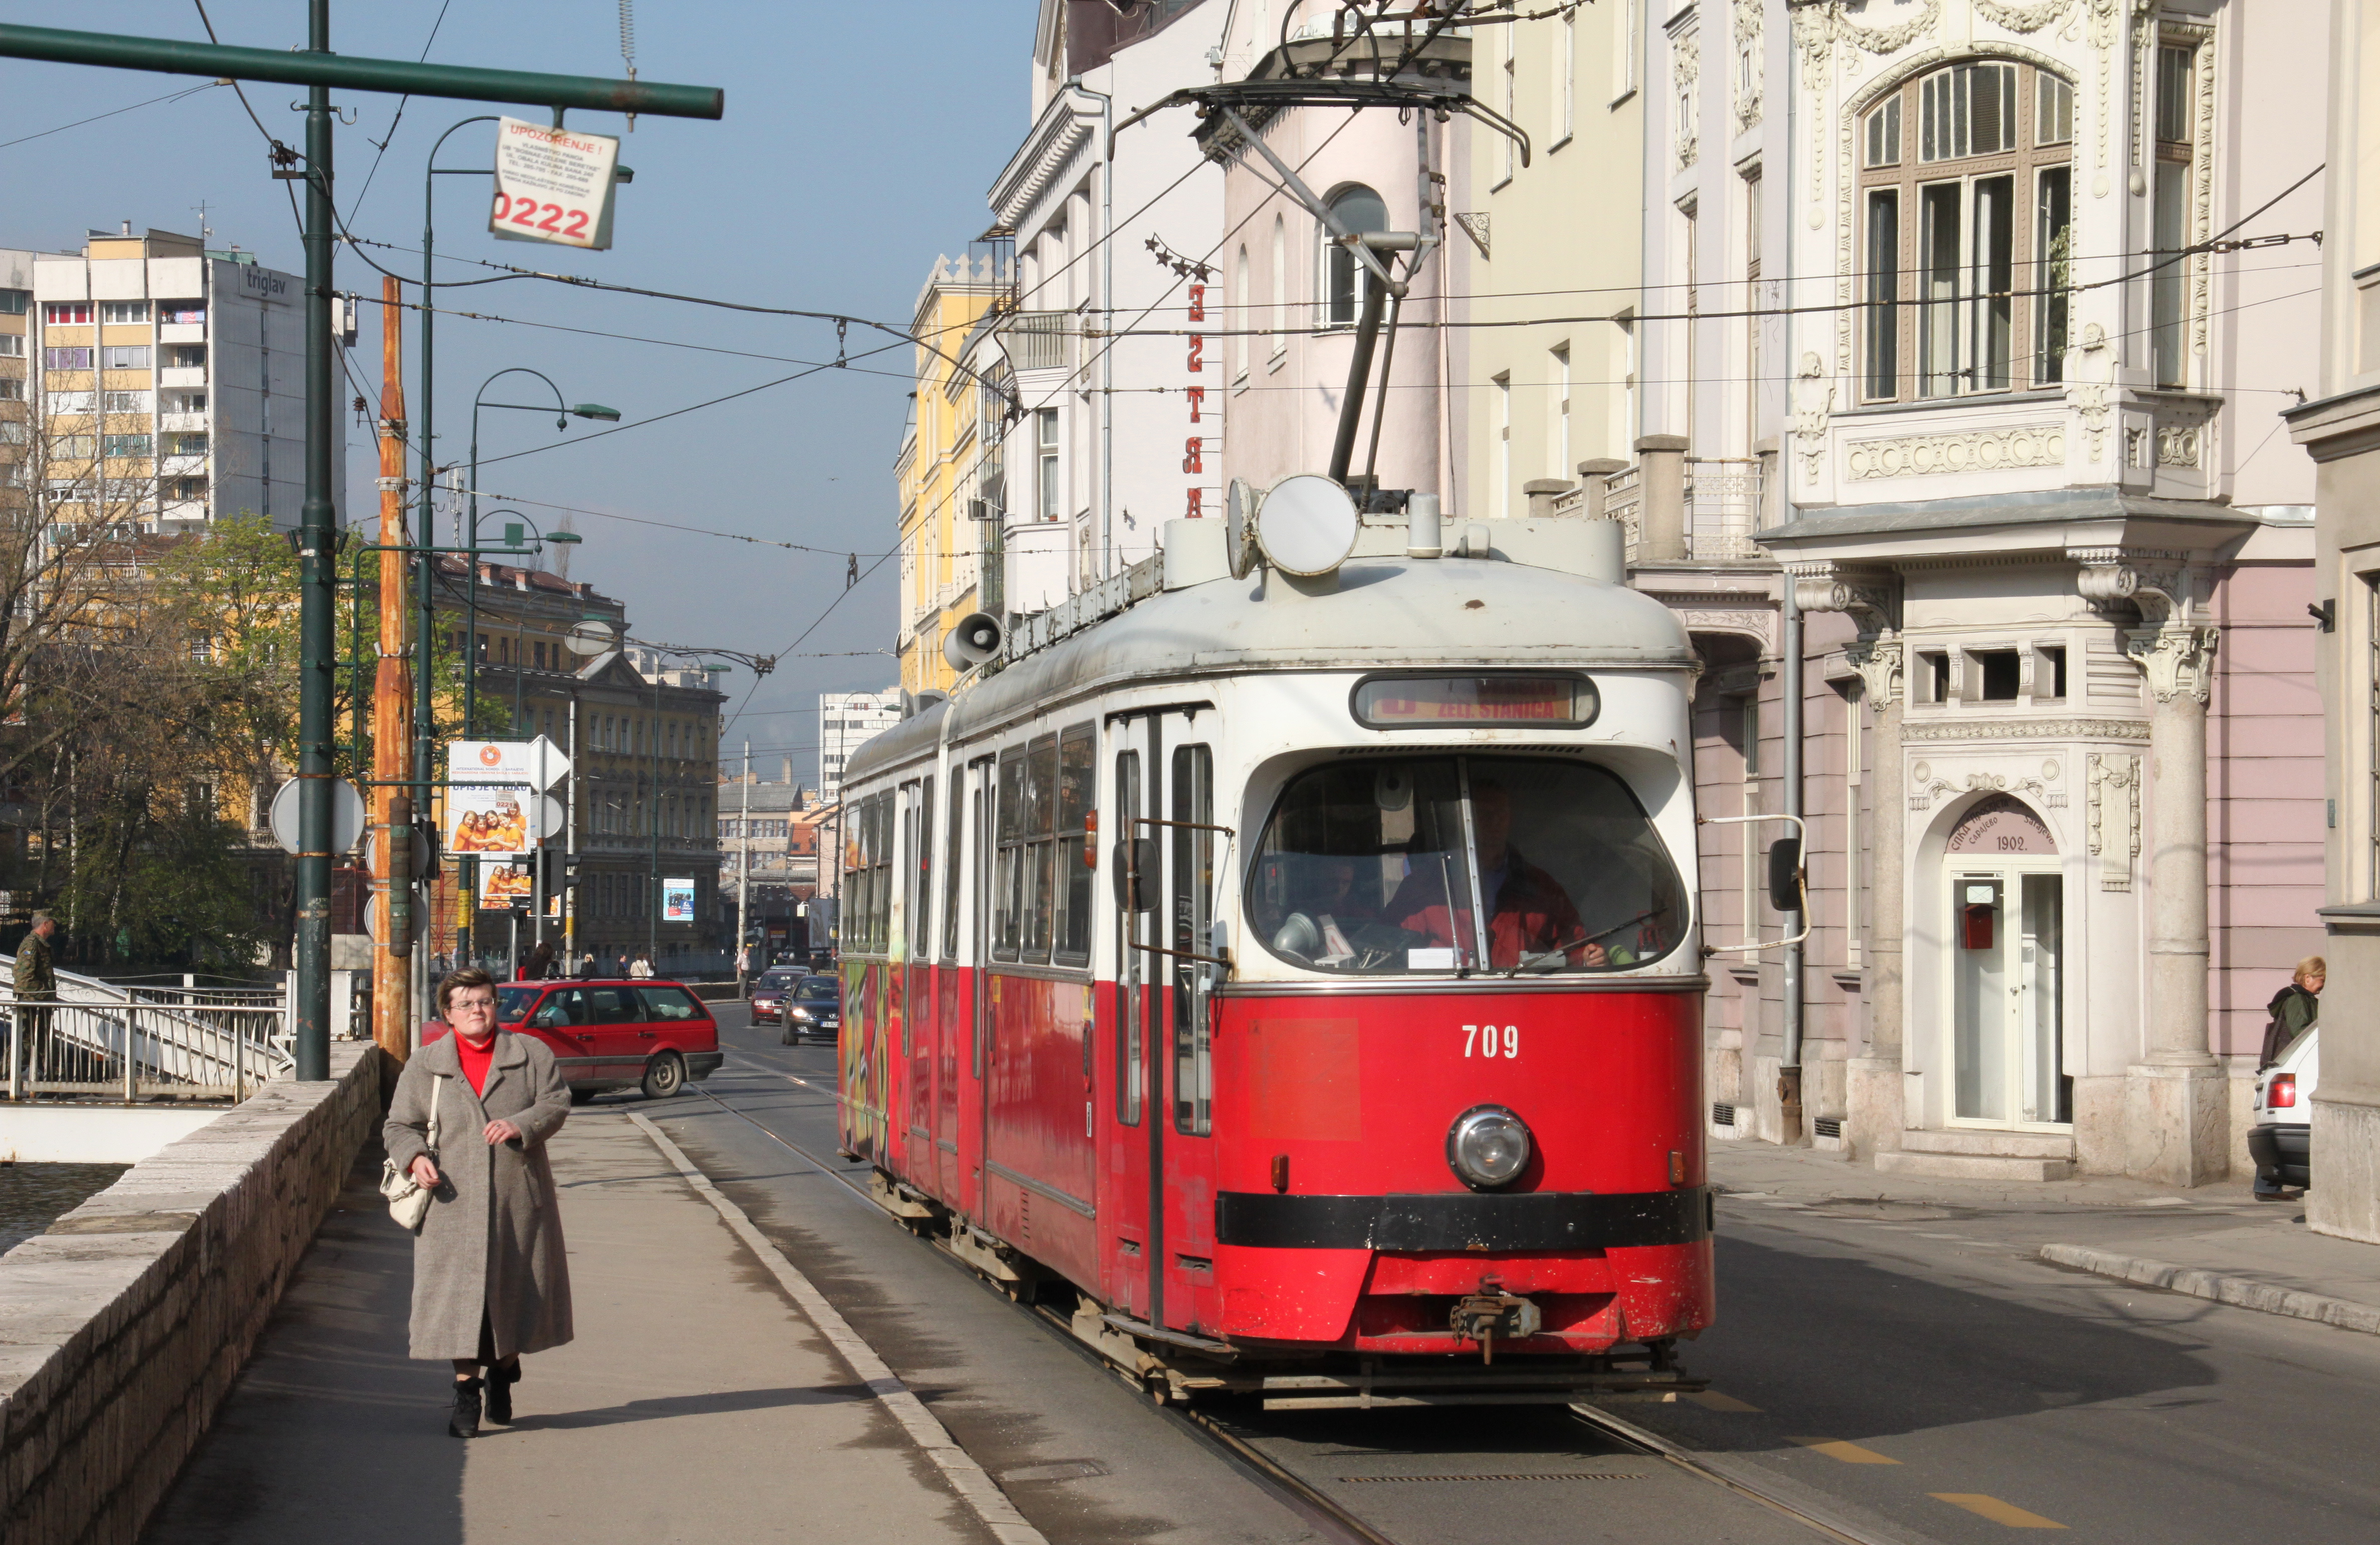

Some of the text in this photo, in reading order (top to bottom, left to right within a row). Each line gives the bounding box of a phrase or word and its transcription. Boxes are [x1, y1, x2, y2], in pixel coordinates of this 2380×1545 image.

[510, 125, 594, 153] UPOZORENJE
[494, 192, 589, 238] 0222
[247, 269, 285, 297] triglav
[1479, 701, 1555, 718] STANICA
[2024, 815, 2054, 845] Sarajevo
[1462, 1025, 1518, 1059] 709
